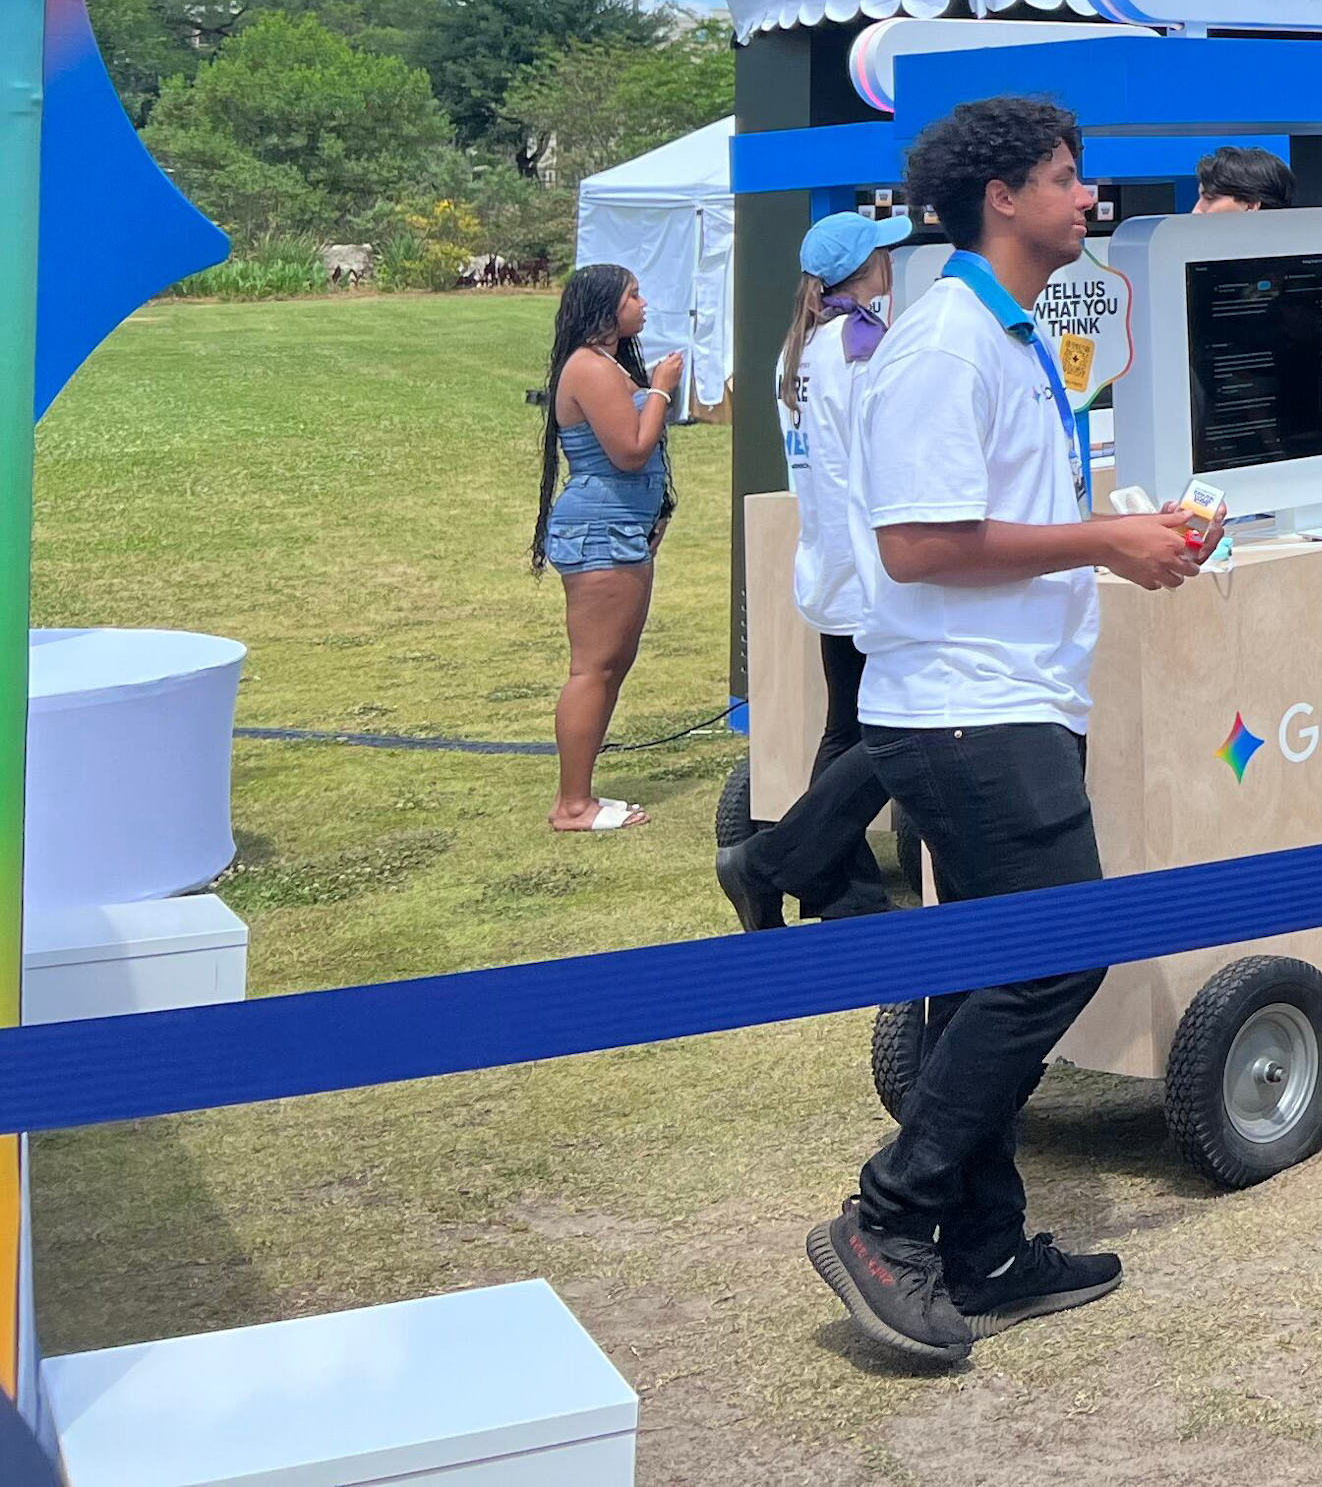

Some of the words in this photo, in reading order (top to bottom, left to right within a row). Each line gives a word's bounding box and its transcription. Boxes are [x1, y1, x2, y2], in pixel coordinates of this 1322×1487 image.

[1045, 282, 1081, 301] TELL
[1084, 280, 1106, 299] US
[1082, 298, 1118, 316] YOU
[1048, 317, 1101, 337] THINK
